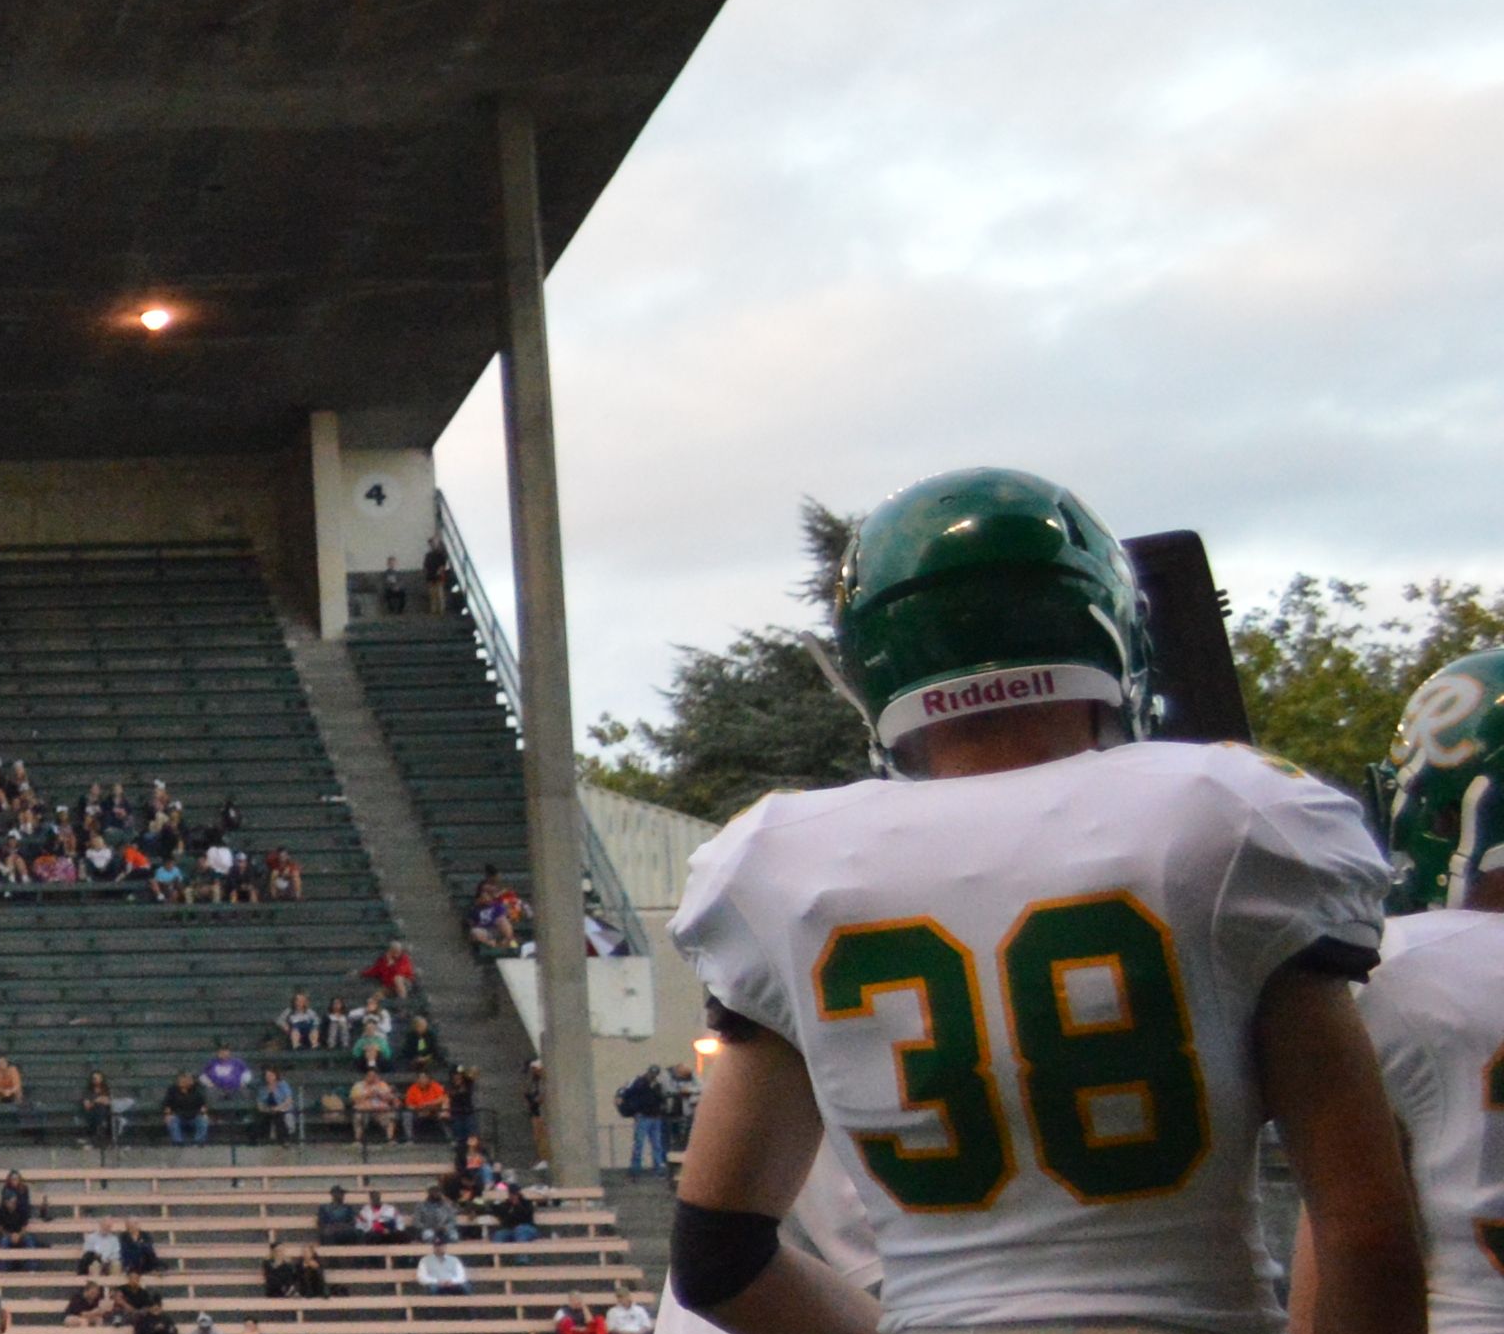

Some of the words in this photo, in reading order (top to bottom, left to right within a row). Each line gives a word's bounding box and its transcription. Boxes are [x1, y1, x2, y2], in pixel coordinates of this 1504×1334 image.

[364, 484, 386, 506] 4
[922, 670, 1056, 717] Riddell
[811, 889, 1213, 1214] 38
